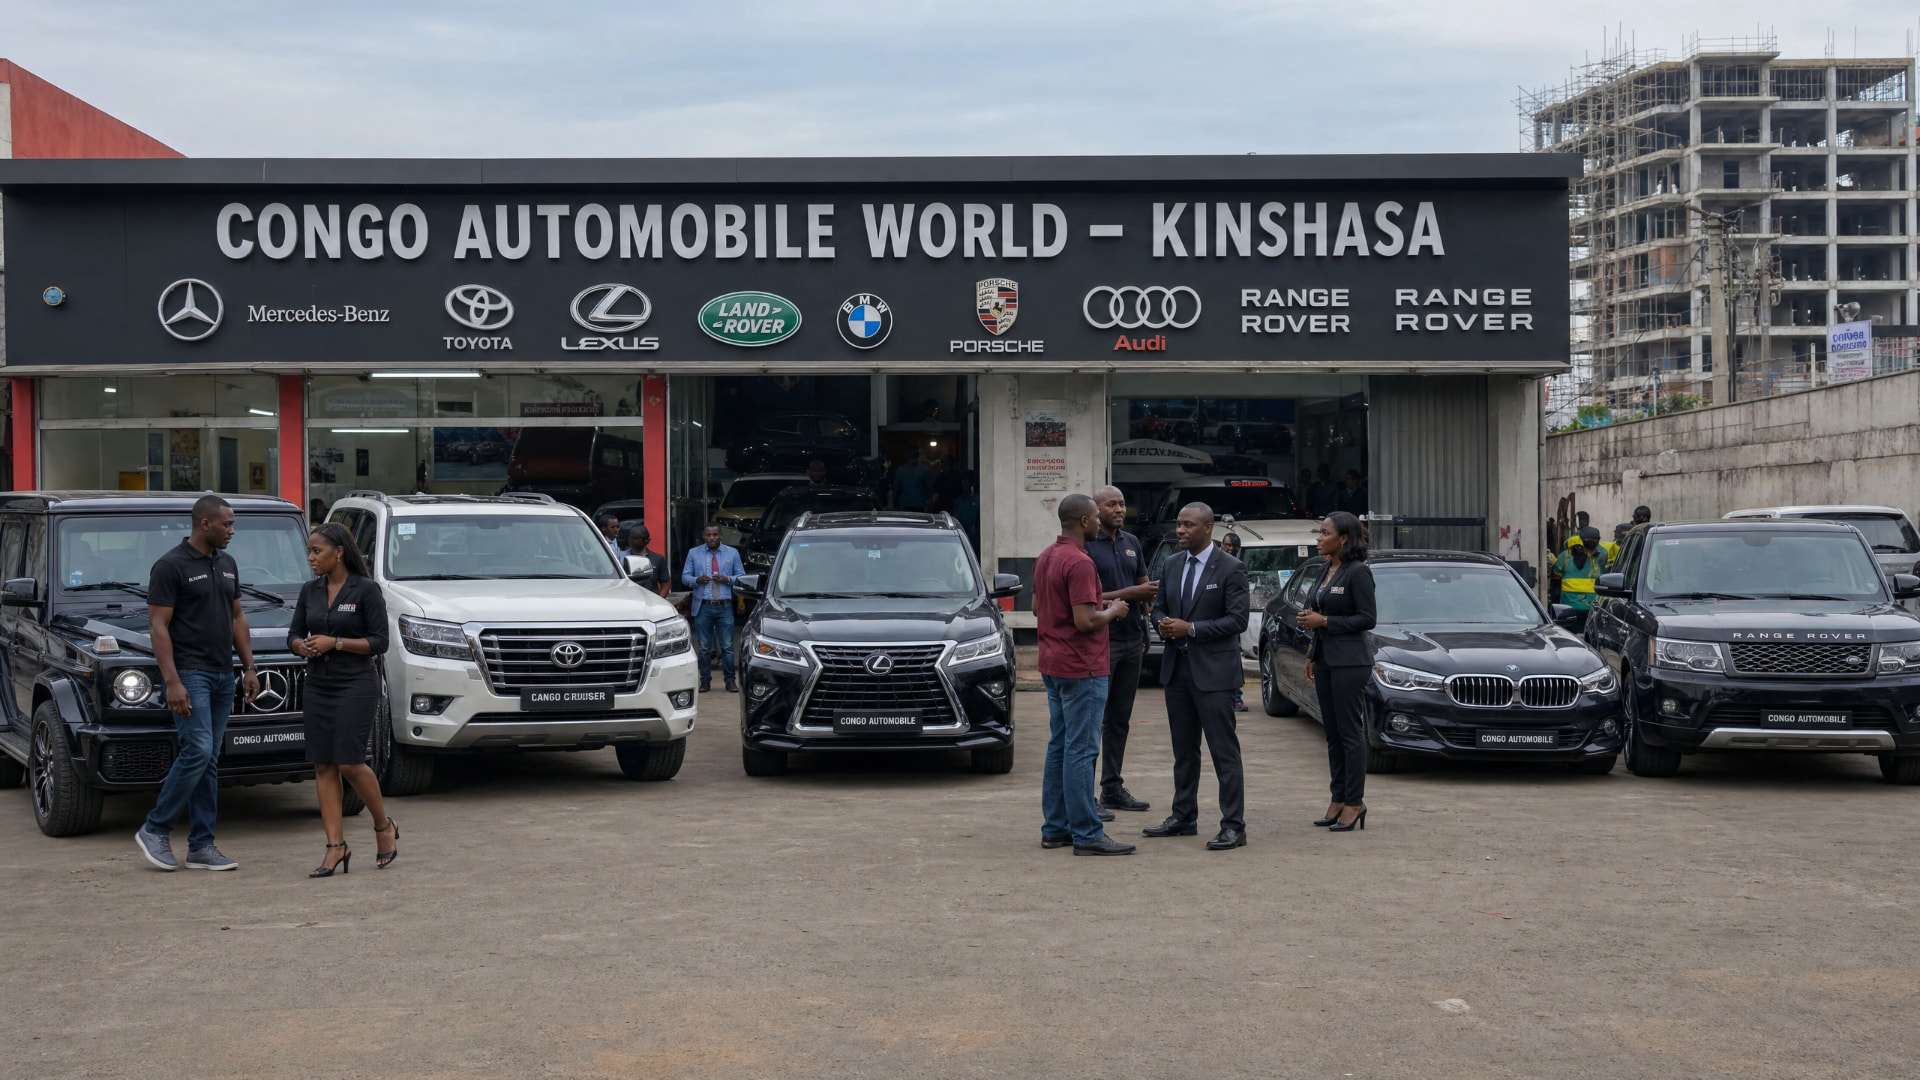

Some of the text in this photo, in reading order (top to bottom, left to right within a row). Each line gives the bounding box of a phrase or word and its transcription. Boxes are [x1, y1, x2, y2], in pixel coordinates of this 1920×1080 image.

[216, 202, 429, 260] CONGO
[454, 202, 836, 260] AUTOMOBILE
[862, 202, 1068, 259] WORLD
[1152, 200, 1446, 258] KINSHASA
[978, 280, 1017, 290] PORSCHE
[1241, 288, 1350, 307] RANGE
[1395, 288, 1532, 306] RANGE
[718, 302, 770, 317] LAND
[842, 295, 887, 314] BMW
[247, 304, 390, 323] Mercedes-Benz
[723, 319, 785, 334] ROVER
[1241, 314, 1351, 333] ROVER
[1395, 313, 1534, 331] ROVER
[443, 336, 513, 350] TOYOTA
[560, 336, 660, 350] LEXUS
[950, 340, 1044, 353] PORSCHE
[1113, 334, 1166, 351] Audi
[1807, 632, 1866, 640] ROVER
[531, 693, 561, 702] CANGO
[840, 716, 916, 725] CONGO AUTOMOBILE
[1768, 714, 1847, 724] CONGO AUTOMOBILE
[233, 732, 306, 745] CONGO AUTOMOBIL
[1481, 735, 1554, 744] CONGO AUTOMOBILE
